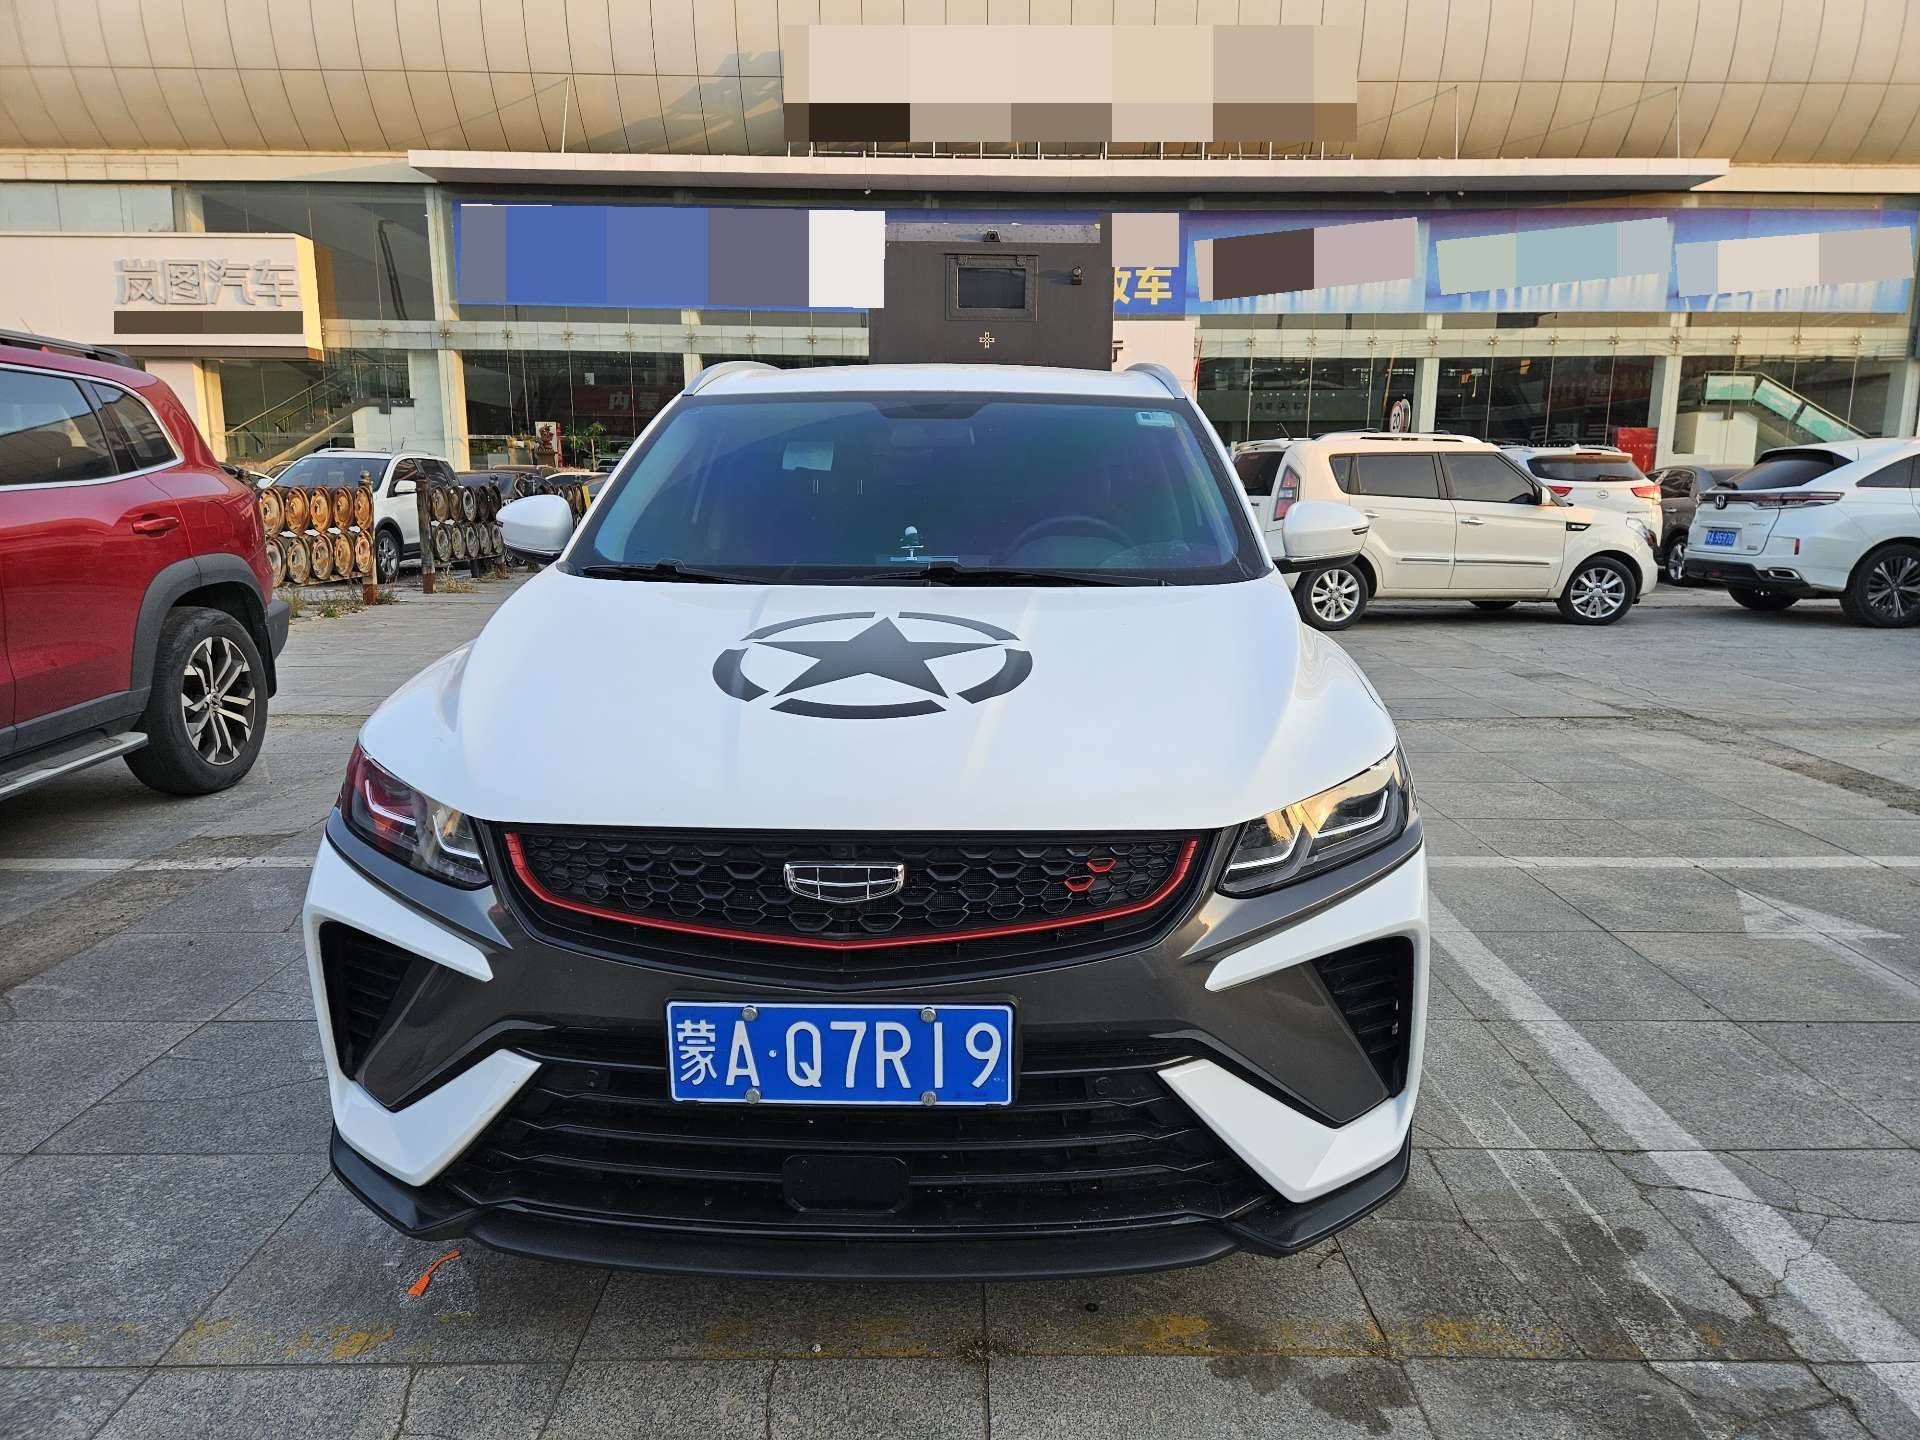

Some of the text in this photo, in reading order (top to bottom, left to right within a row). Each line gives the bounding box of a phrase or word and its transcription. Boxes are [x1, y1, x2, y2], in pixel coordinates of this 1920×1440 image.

[117, 259, 298, 306] 岚图汽车
[676, 1019, 1002, 1089] 蒙A·Q7R19
